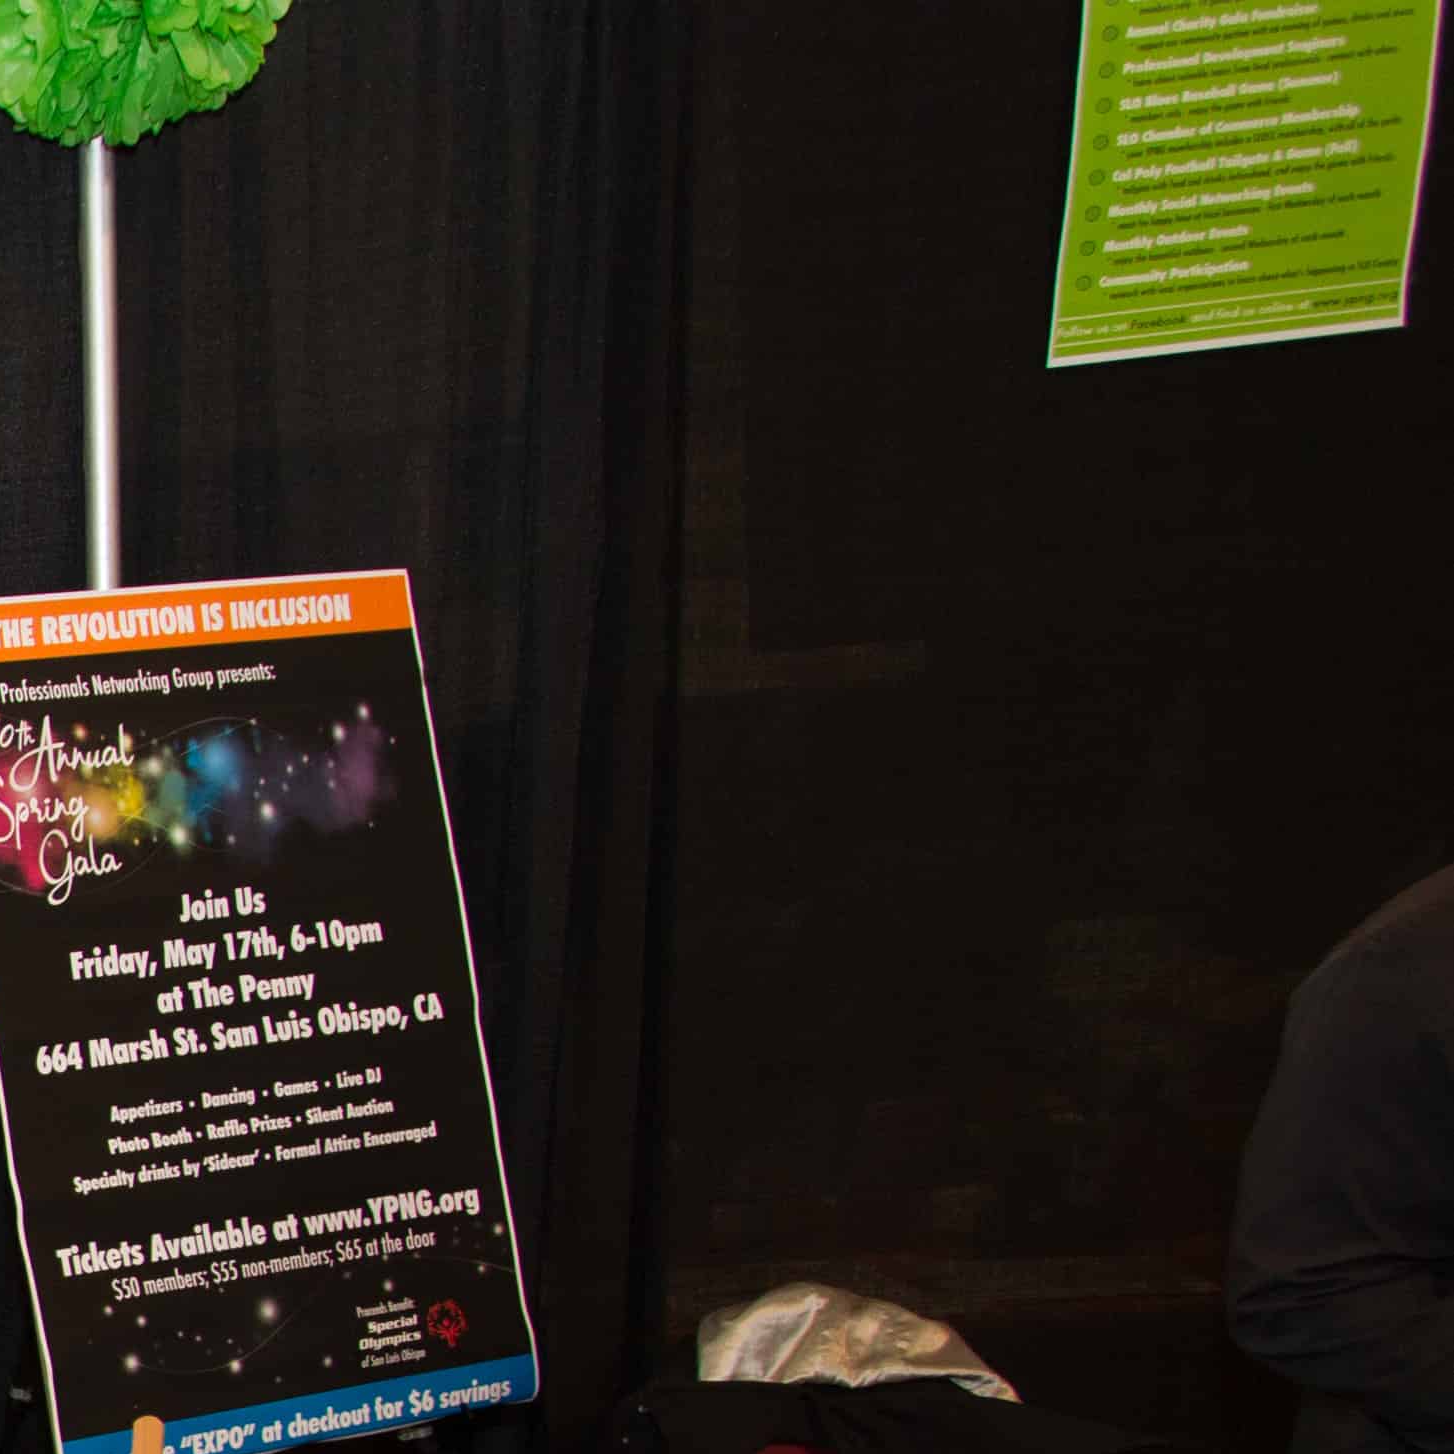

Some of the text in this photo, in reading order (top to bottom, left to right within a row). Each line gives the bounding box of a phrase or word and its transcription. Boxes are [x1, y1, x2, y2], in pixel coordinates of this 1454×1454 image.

[41, 604, 195, 646] REVOLUTION
[202, 601, 224, 632] IS
[230, 593, 352, 630] INCLUSION
[0, 674, 90, 704] Professionals
[92, 668, 170, 697] Networking
[172, 666, 214, 690] Group
[217, 663, 276, 687] presents:
[9, 714, 134, 793] Annual
[39, 829, 123, 905] Gala
[179, 886, 267, 923] Join Us
[69, 919, 384, 981] Friday, May 17th, 6-10pm
[156, 972, 315, 1014] at The Penny
[36, 992, 444, 1076] 664 Marsh St. San Luis Obispo, CA
[110, 1066, 382, 1124] Appetizers Dancing Games Live DJ
[108, 1098, 394, 1155] Photo Booth Raffle Prizes Silent Auction
[73, 1168, 136, 1196] Specialty
[138, 1160, 181, 1184] drinks
[182, 1158, 202, 1178] by
[274, 1140, 321, 1162] Formal
[324, 1133, 361, 1154] Attire
[363, 1120, 437, 1148] Encouraged
[55, 1187, 481, 1278] Tickets Available at www.YPNG.org
[111, 1229, 436, 1301] $50 members; $55 non-members; $65 at the door
[358, 1330, 422, 1350] Olympics
[368, 1314, 418, 1334] Special
[261, 1420, 283, 1443] at
[288, 1404, 371, 1440] checkout
[374, 1396, 405, 1421] for
[408, 1388, 435, 1417] $6
[439, 1378, 512, 1411] savings
